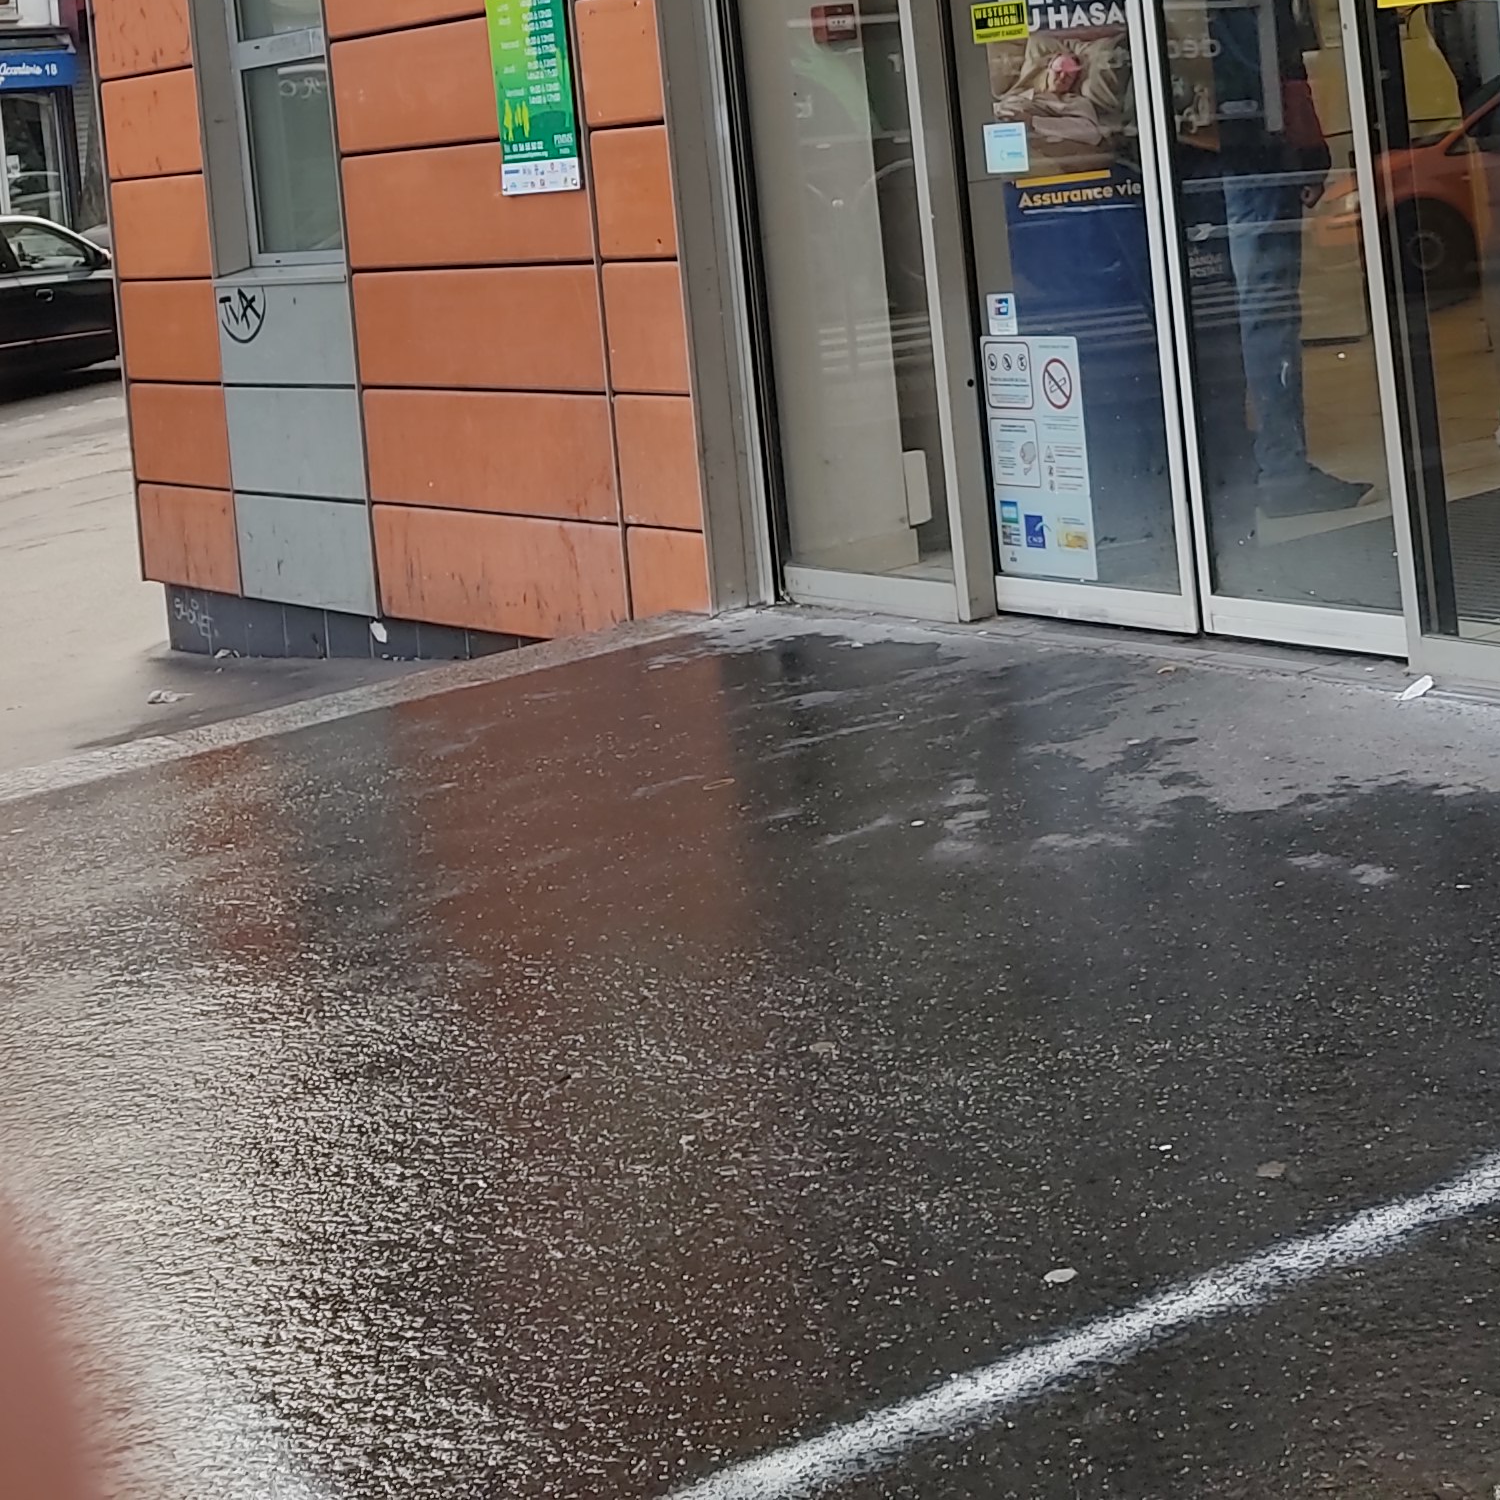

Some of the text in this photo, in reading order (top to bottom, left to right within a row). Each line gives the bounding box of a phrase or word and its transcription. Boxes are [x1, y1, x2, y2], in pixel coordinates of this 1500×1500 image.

[975, 4, 1017, 20] WESTERN
[987, 15, 1017, 28] UNION
[1047, 1, 1126, 30] HASA
[1018, 178, 1142, 208] Assurance vie
